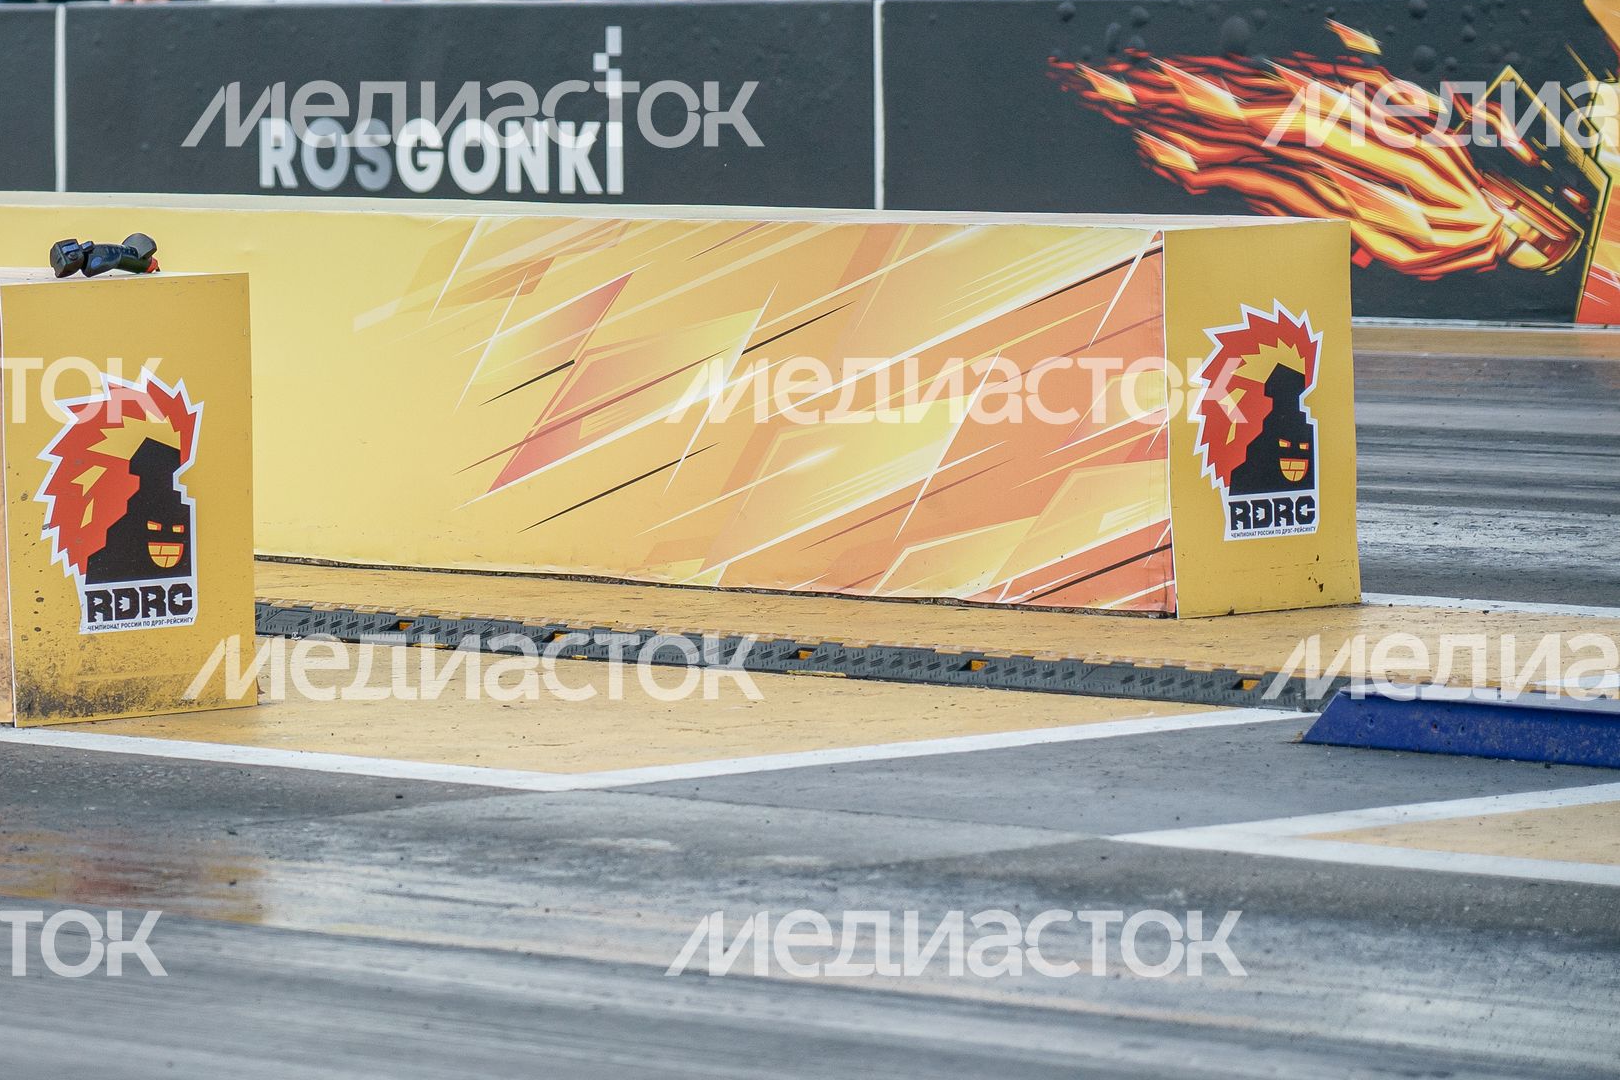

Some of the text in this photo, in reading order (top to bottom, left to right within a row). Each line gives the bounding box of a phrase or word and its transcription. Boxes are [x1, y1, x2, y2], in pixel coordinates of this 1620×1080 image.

[257, 68, 624, 196] ROSGONKI
[1228, 495, 1316, 531] RDRC
[84, 583, 193, 623] RDRC
[86, 622, 119, 632] ЧЕМПИОНАТ
[151, 616, 193, 627] ДРЭГ-РЕЙСИНГУ
